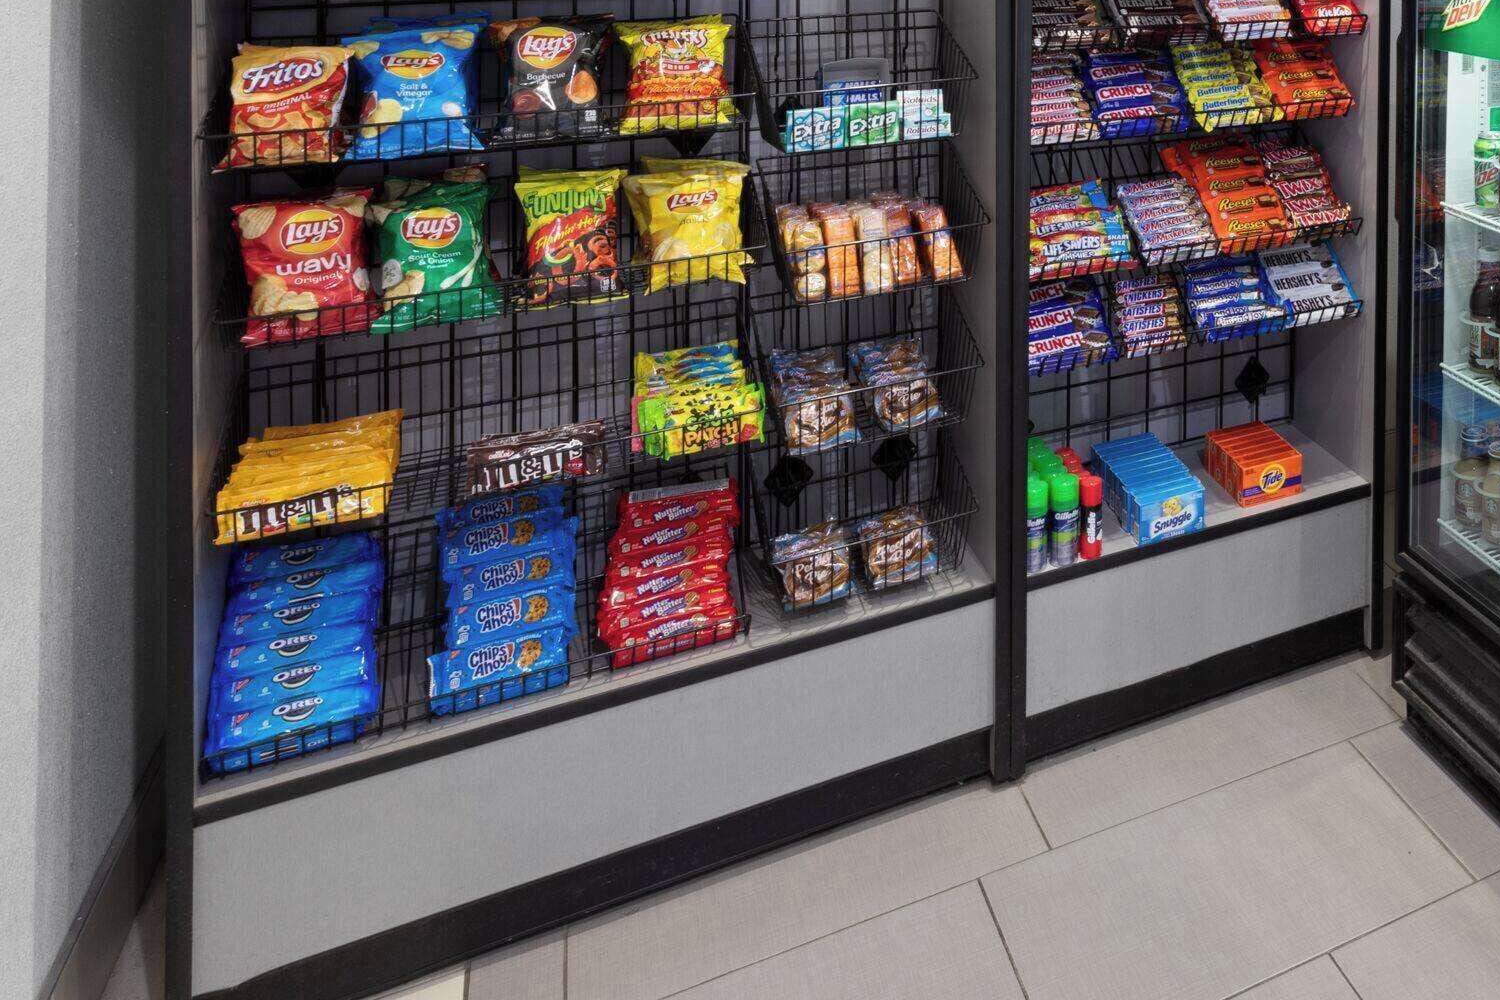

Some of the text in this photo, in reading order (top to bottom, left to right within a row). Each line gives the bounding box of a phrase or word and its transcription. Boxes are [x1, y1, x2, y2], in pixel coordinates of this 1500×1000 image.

[1128, 14, 1183, 26] HERSHEY'S
[522, 30, 577, 57] Lay's
[388, 52, 443, 68] Lay's
[242, 59, 324, 93] Fritos
[1092, 63, 1143, 79] CRUNCH
[846, 91, 879, 102] HALLS
[1099, 84, 1150, 100] CRUNCH
[1197, 85, 1243, 97] Butterfinger
[263, 91, 312, 110] ORIGINAL
[1203, 97, 1250, 110] Butterfinger
[794, 115, 842, 140] Extra
[849, 111, 896, 136] Extra
[1265, 149, 1308, 164] TWIX
[1276, 178, 1323, 198] TWIX
[523, 189, 607, 218] FUNYUNS
[669, 189, 719, 210] Lay's
[1218, 197, 1257, 212] Reese's
[1286, 197, 1330, 213] TWIX
[406, 212, 459, 239] Lay's
[1228, 219, 1267, 232] Reese's
[1297, 209, 1344, 227] TWIX
[285, 214, 342, 246] Lay's
[1036, 223, 1059, 236] LIFE
[433, 250, 461, 259] Cream
[1042, 242, 1064, 256] LIFE
[1063, 236, 1101, 251] SAVERS
[275, 252, 352, 277] wavy
[428, 257, 455, 265] Onion
[1263, 250, 1312, 268] HERSHEY'S
[294, 271, 344, 285] Original
[1274, 272, 1322, 291] HERSHEY'S
[1029, 283, 1064, 300] UNCH
[1123, 289, 1163, 302] SNICKERS
[1123, 305, 1161, 318] SATISFIES
[1294, 295, 1334, 313] ERSHEY'S
[1029, 310, 1073, 328] RUNCH
[1124, 318, 1165, 333] SATISFIES
[1029, 334, 1082, 355] CRUNCH
[684, 420, 739, 447] PATCH
[1261, 472, 1284, 490] Tide
[653, 505, 681, 522] Nutter
[668, 505, 694, 520] Butter
[1054, 510, 1079, 521] Gillette
[1087, 512, 1096, 543] Gillette
[1153, 511, 1192, 534] Snuggle
[464, 525, 501, 546] Chips
[642, 528, 670, 545] Nutter
[656, 528, 683, 544] Butter
[641, 551, 668, 568] Nutter
[656, 551, 683, 567] Butter
[481, 560, 517, 583] Chips
[637, 577, 665, 595] Nutter
[651, 575, 679, 593] Butter
[476, 600, 513, 623] Chips
[640, 599, 669, 618] Nutter
[656, 598, 684, 616] Butter
[647, 620, 676, 639] Nutter
[663, 619, 689, 636] Butter
[269, 633, 319, 650] OREO
[468, 645, 506, 669] Chips
[272, 664, 322, 682] OREO
[272, 696, 324, 715] OREO
